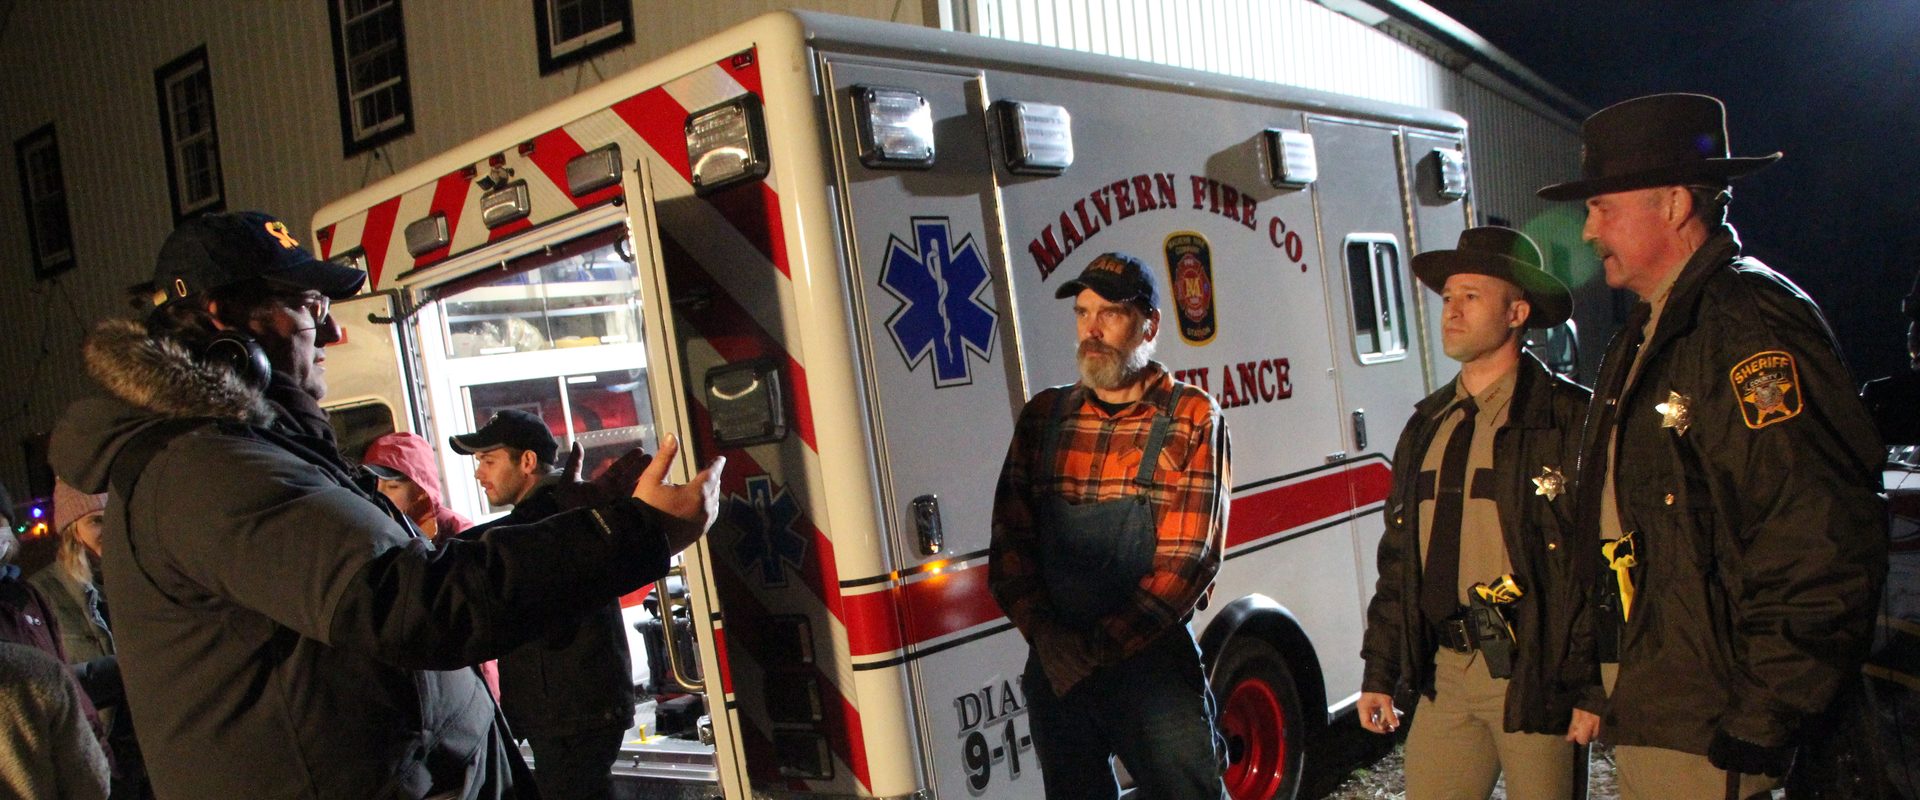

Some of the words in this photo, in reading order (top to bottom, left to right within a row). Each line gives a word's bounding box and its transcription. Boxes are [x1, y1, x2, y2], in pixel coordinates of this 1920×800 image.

[1028, 173, 1177, 282] MALVERN
[1190, 175, 1257, 231] FIRE
[1269, 216, 1307, 273] CO.
[1735, 356, 1789, 384] SHERIFF
[962, 719, 1032, 794] 9-1-
